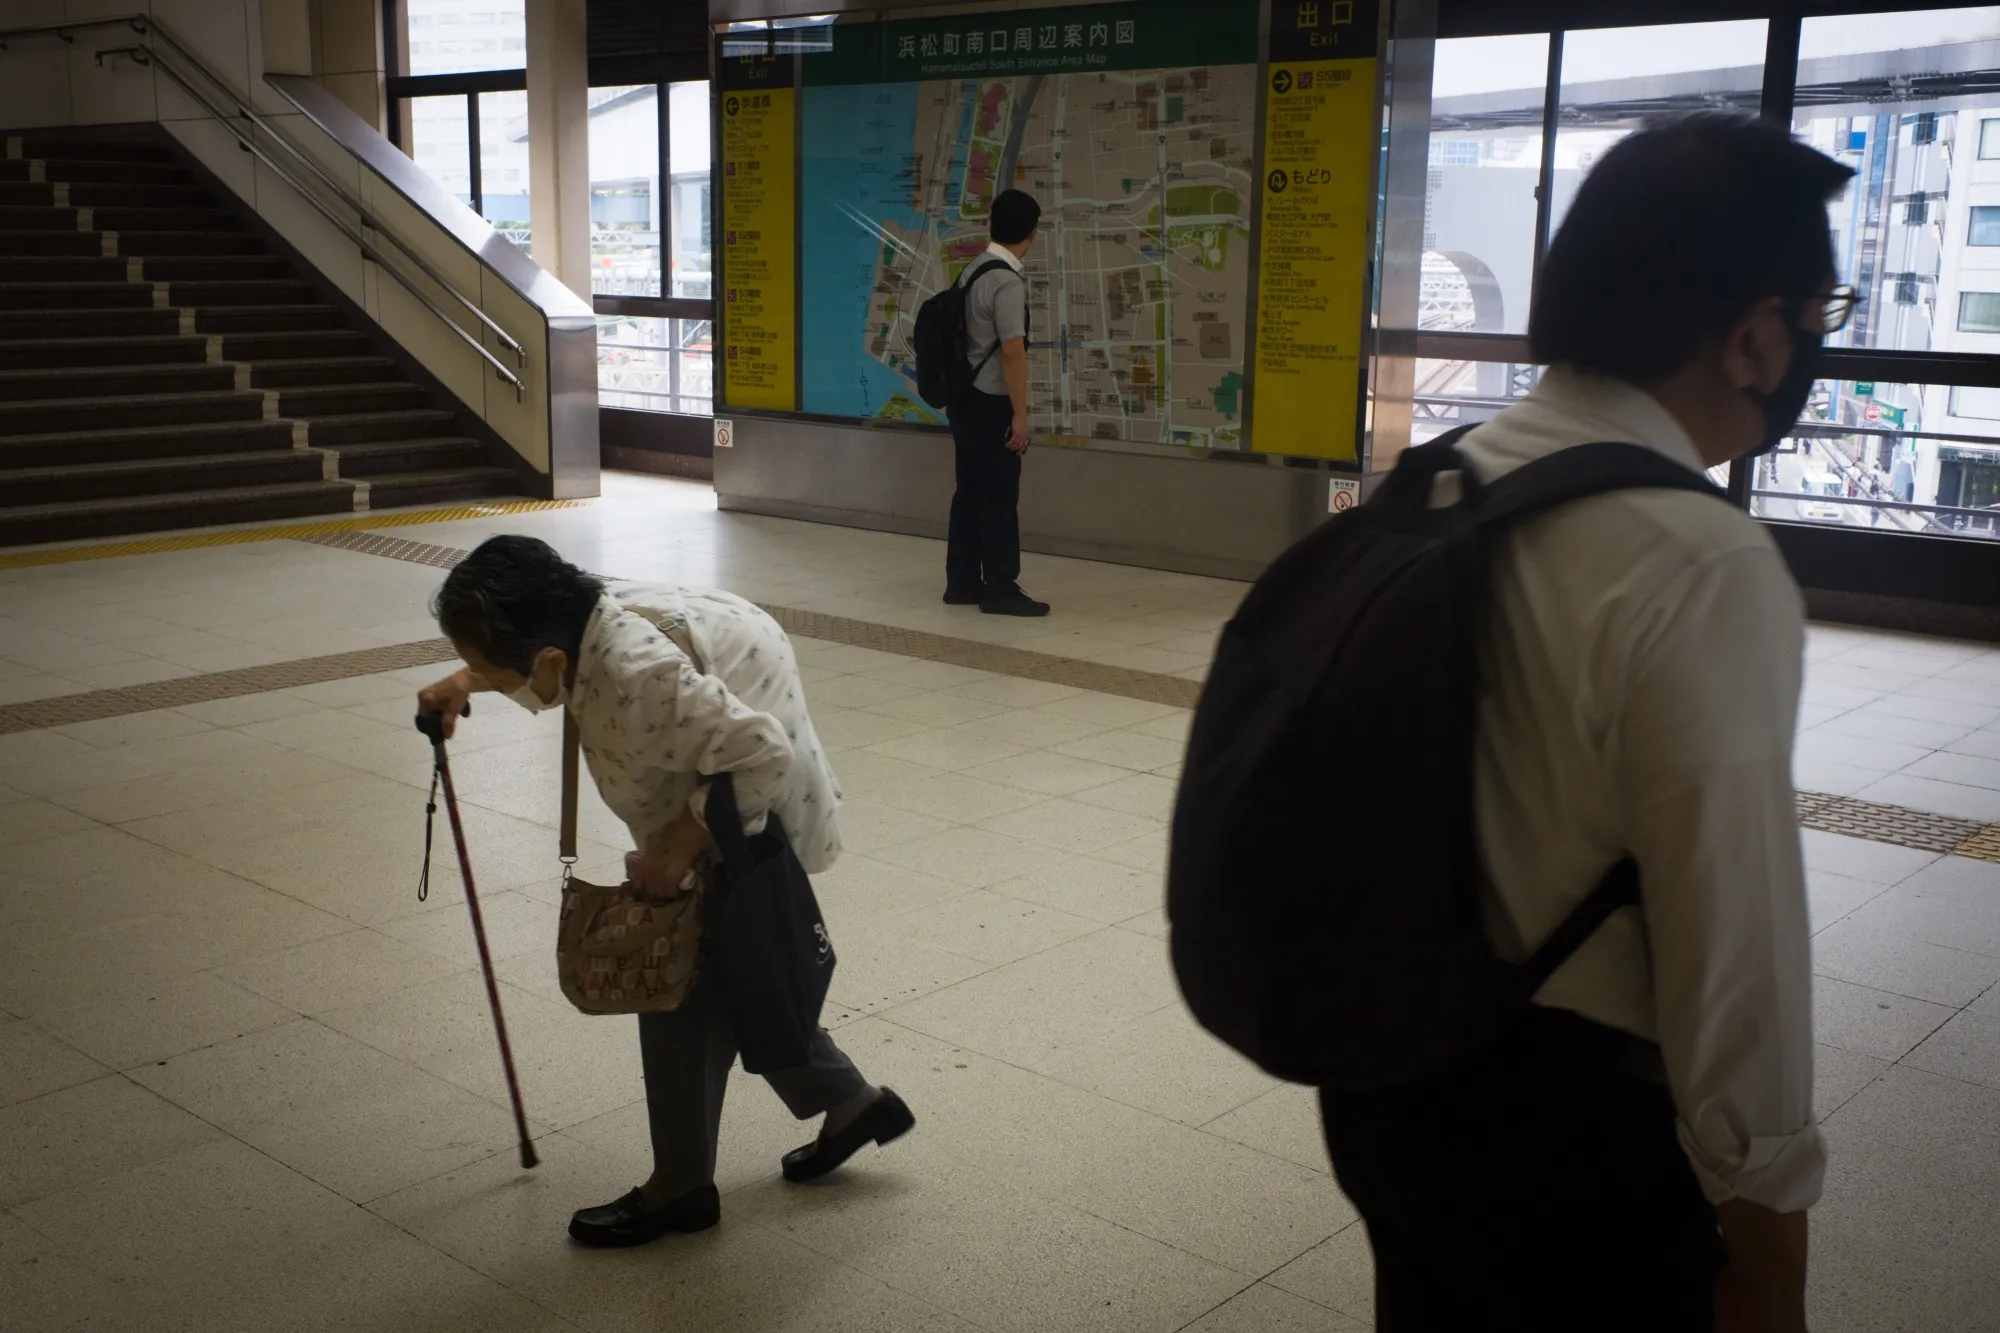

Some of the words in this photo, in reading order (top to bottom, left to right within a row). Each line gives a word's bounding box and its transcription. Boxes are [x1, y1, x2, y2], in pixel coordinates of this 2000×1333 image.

[1297, 1, 1353, 29] 出口
[897, 20, 1135, 59] 浜松町南口周辺案内図
[1310, 31, 1338, 47] Exit
[989, 58, 1015, 71] South
[1018, 55, 1059, 70] Entrance
[1060, 54, 1083, 67] Area
[1086, 53, 1107, 66] Map
[748, 67, 768, 80] Exit
[1292, 168, 1331, 184] もどり
